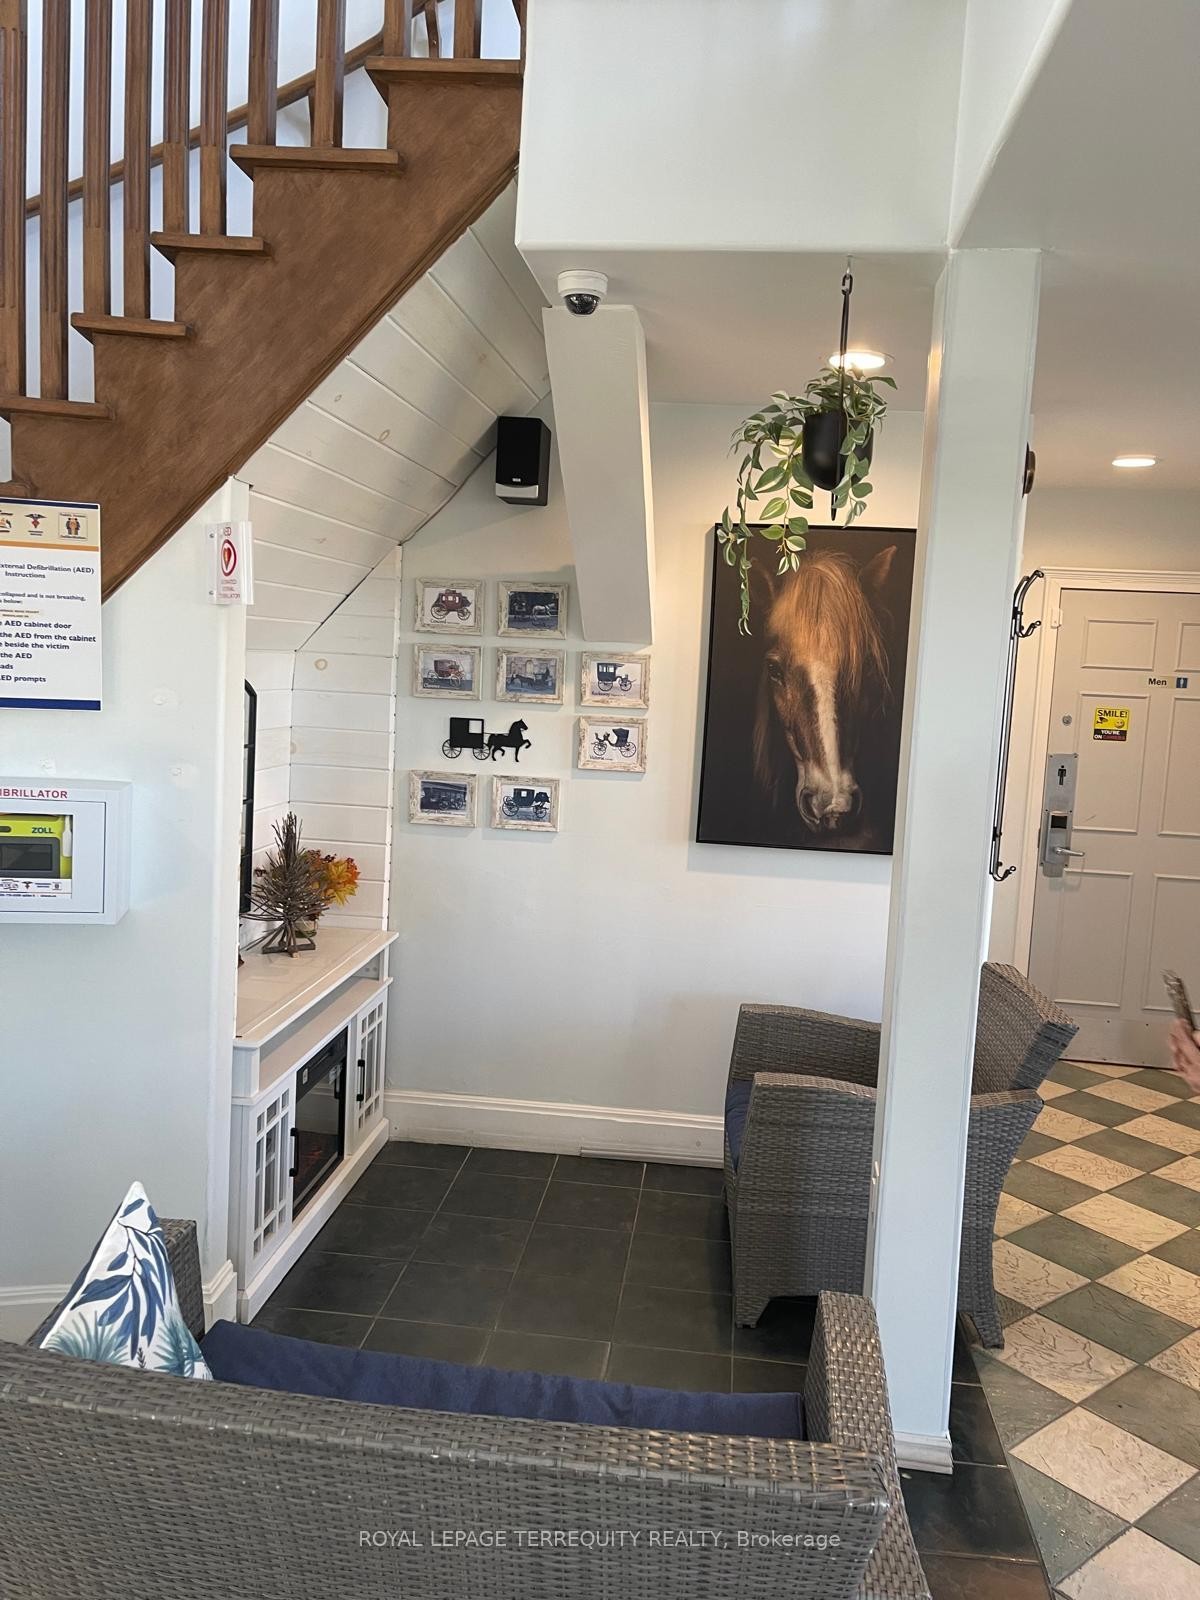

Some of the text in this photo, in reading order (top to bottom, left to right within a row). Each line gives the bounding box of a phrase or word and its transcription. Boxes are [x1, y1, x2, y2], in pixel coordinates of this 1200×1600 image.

[27, 564, 72, 572] Defibrillation
[5, 571, 46, 579] Instructions
[1148, 678, 1167, 686] Men
[1097, 709, 1128, 718] SMILE!
